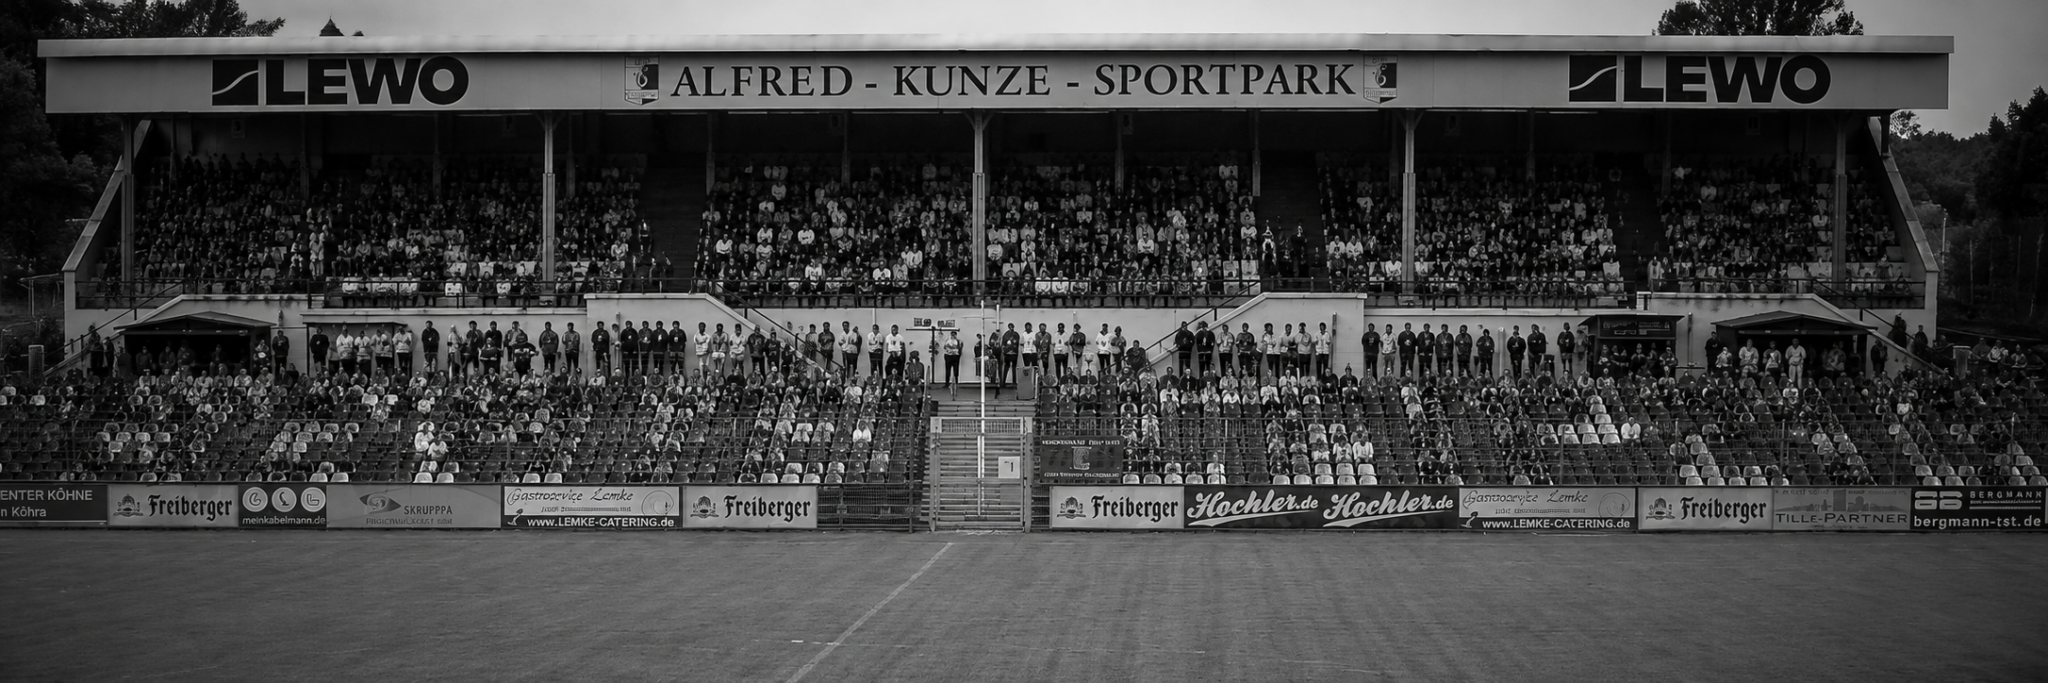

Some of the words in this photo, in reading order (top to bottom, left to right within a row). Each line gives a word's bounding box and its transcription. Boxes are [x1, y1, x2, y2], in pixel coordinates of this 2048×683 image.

[265, 55, 470, 106] LEWO
[670, 65, 854, 97] ALFRED
[893, 65, 1051, 97] KUNZE
[1094, 63, 1356, 96] SPORTPARK
[1623, 54, 1831, 105] LEWO
[0, 489, 45, 501] ENTER
[47, 487, 93, 501] KÖHNE
[590, 487, 634, 501] Lemke
[1546, 489, 1589, 503] Lemke
[11, 505, 47, 517] Köhra
[147, 494, 233, 522] Freiberger
[723, 494, 812, 523] Freiberger
[1091, 495, 1179, 522] Freiberger
[1680, 496, 1767, 524] Freiberger
[242, 516, 326, 525] meinkabelmann.de
[527, 517, 675, 528] www.LEMKE-CATERING.de
[1482, 518, 1630, 529] www.LEMKE-CATERING.de
[1914, 515, 2042, 530] bergmann-tst.de
